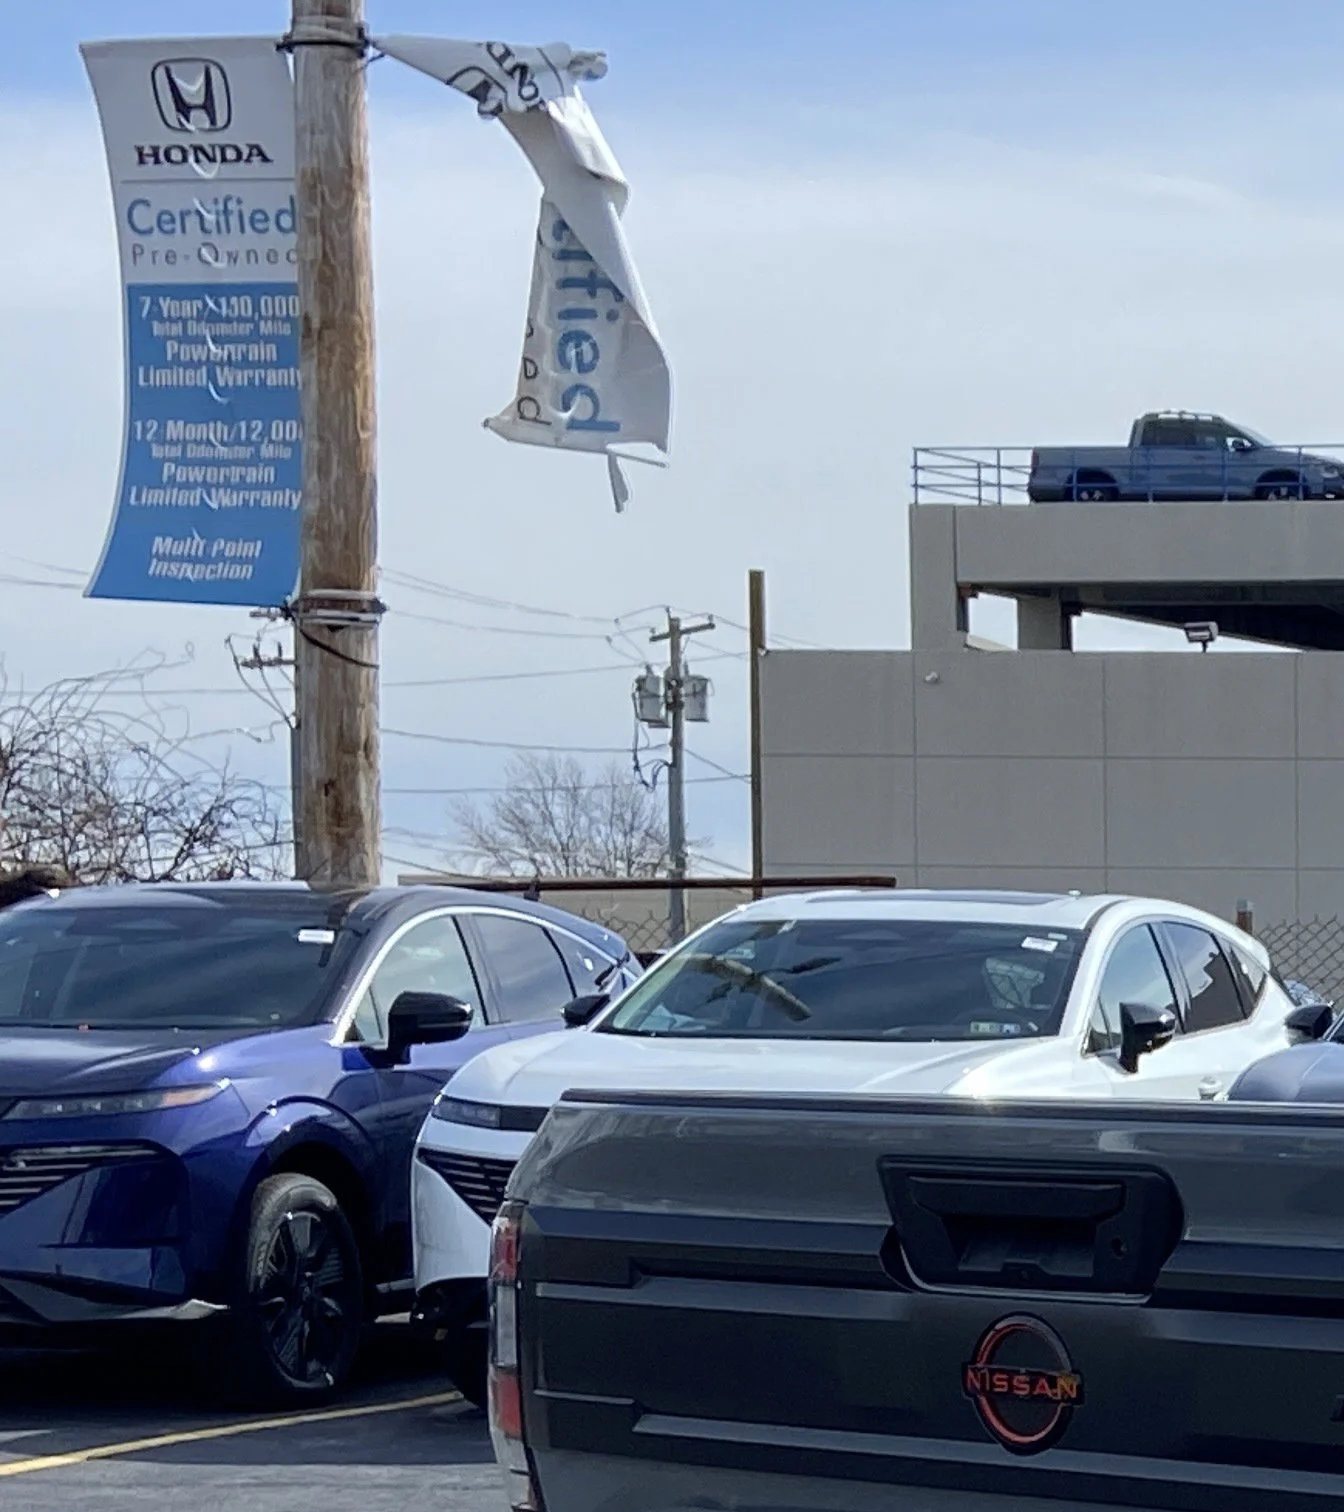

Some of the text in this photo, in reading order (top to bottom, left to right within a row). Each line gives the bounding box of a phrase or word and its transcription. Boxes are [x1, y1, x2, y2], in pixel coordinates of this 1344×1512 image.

[134, 143, 274, 165] HONDA
[127, 194, 297, 236] Certified
[166, 340, 278, 362] Powertrain
[138, 366, 208, 387] Limited
[166, 420, 303, 446] Month/12,00
[162, 462, 275, 484] Powertrain
[130, 485, 202, 507] Limited
[148, 558, 254, 581] Inspection
[967, 1368, 1078, 1399] NISSAN
